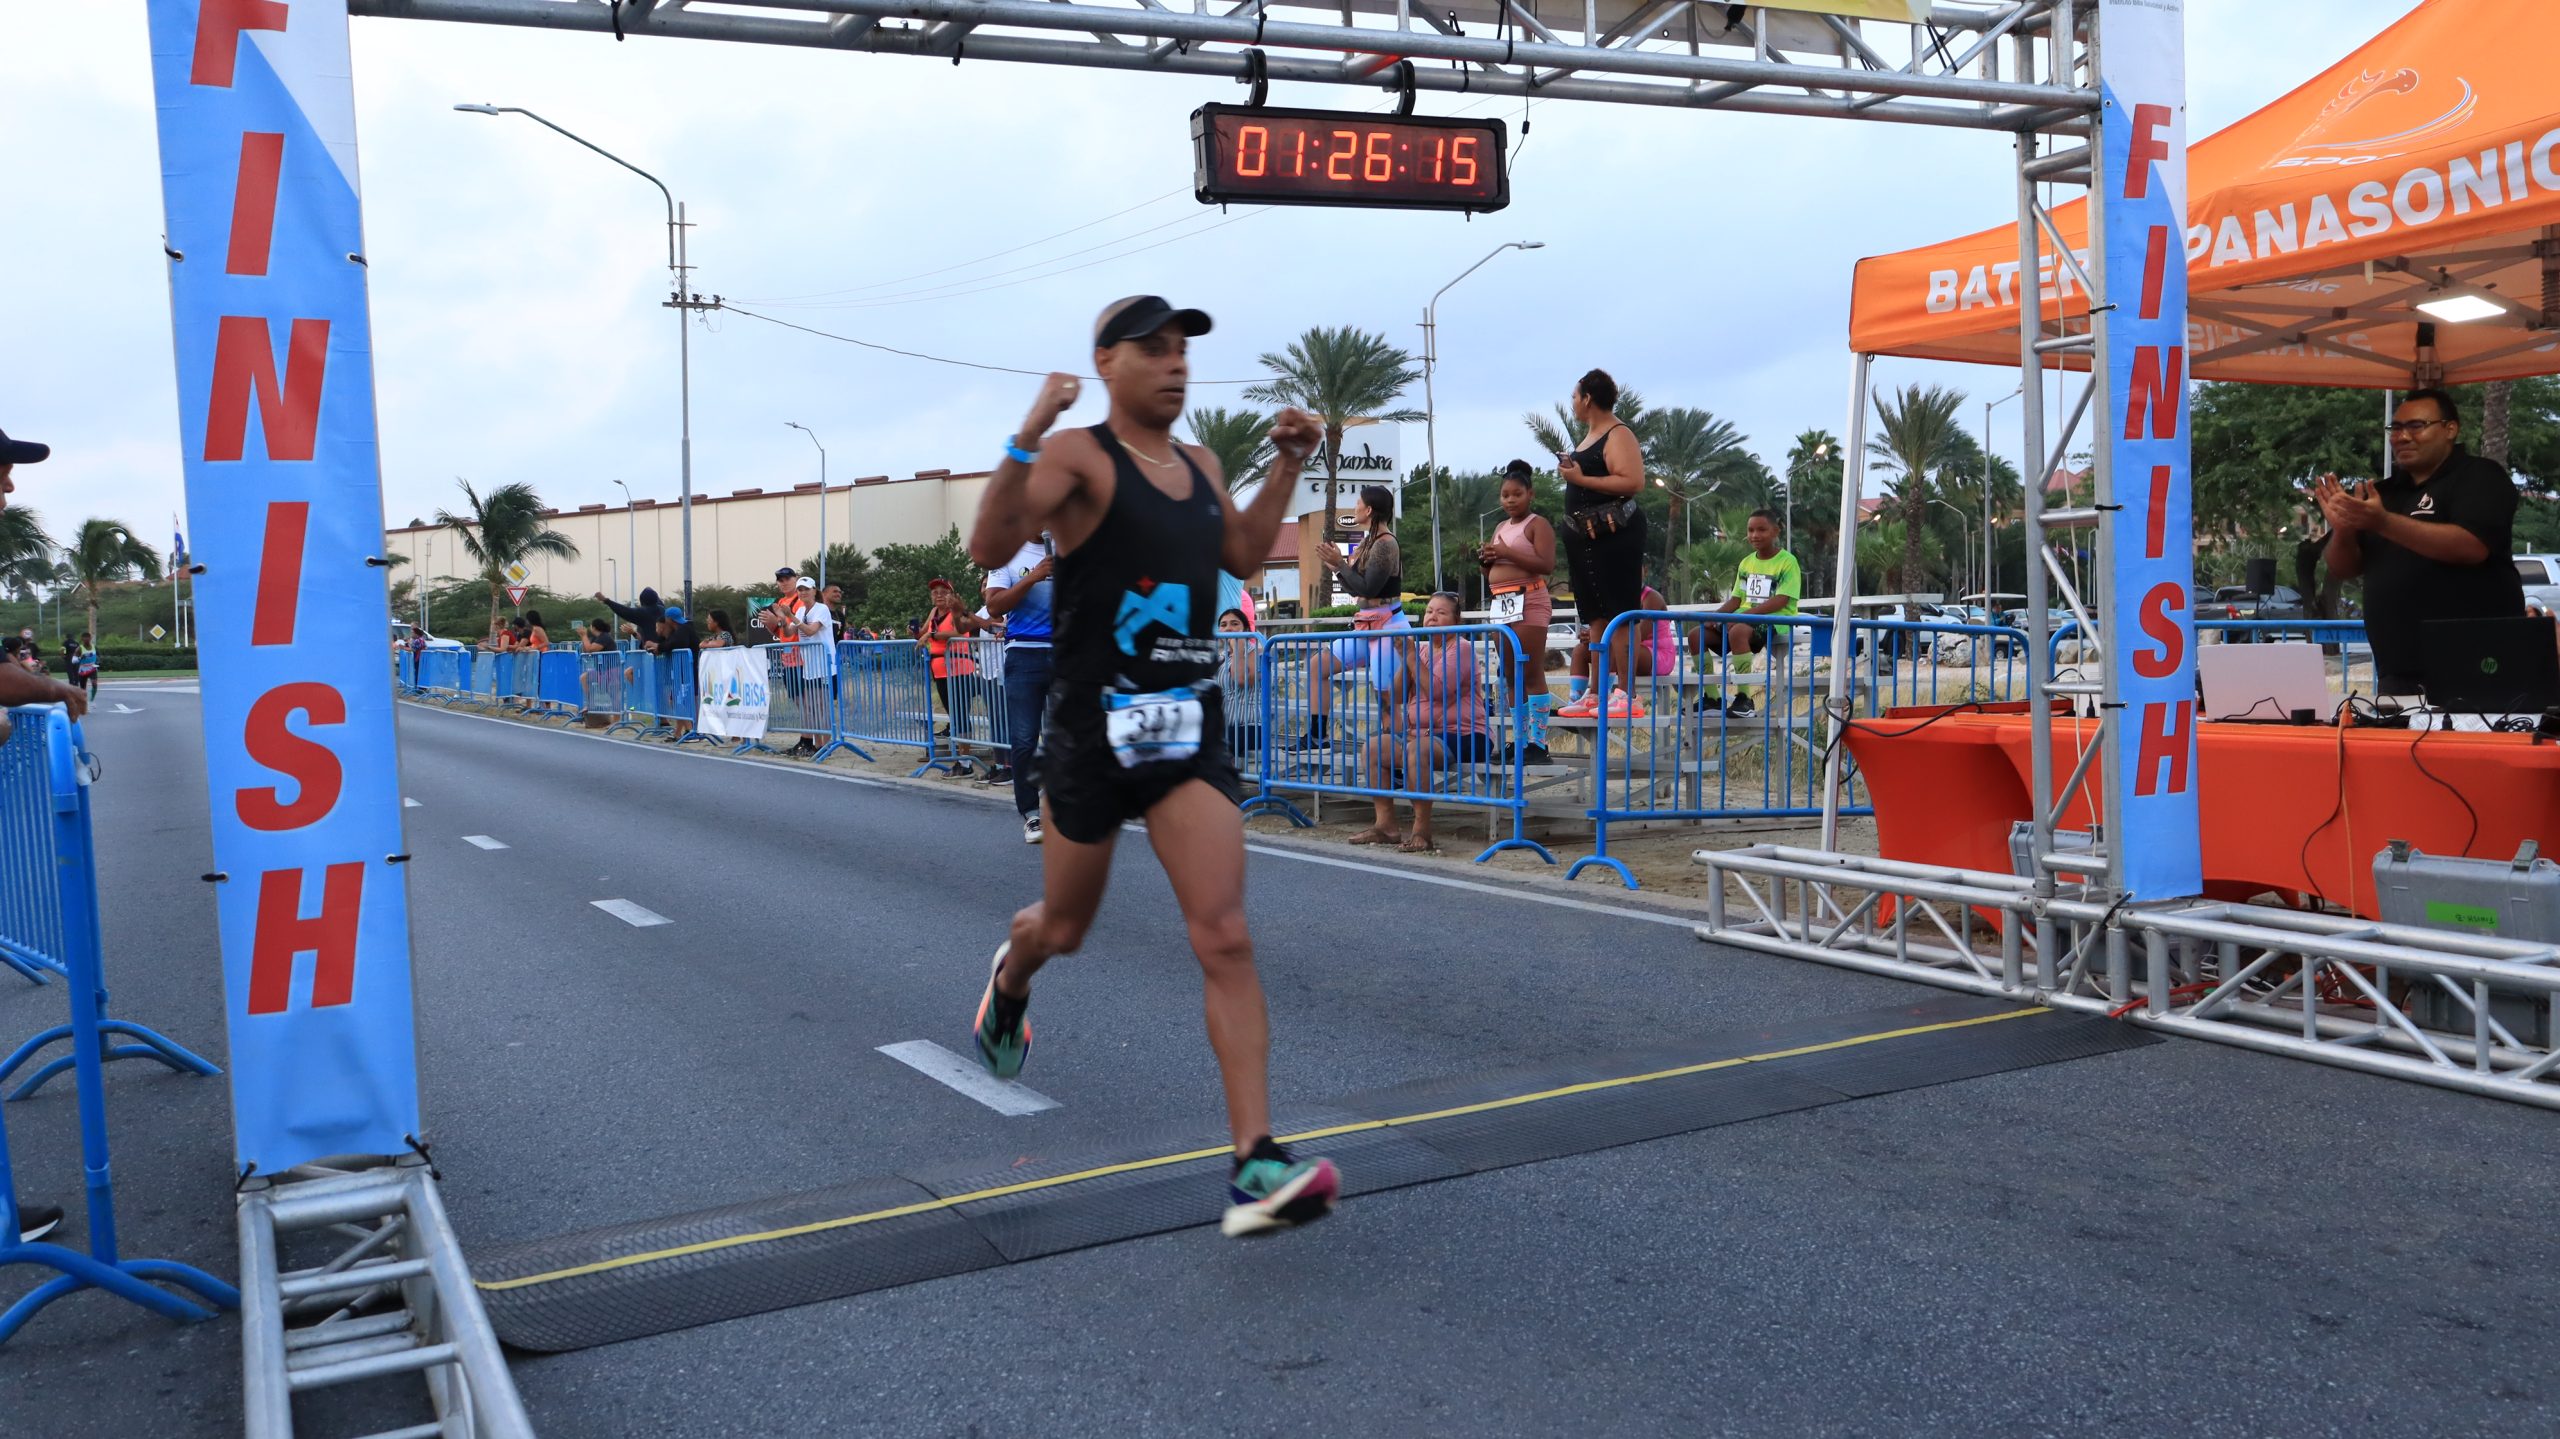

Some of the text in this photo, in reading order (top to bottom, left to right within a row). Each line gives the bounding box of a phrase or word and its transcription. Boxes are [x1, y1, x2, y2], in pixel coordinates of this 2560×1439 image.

[1236, 125, 1478, 186] 01:26:15
[2270, 155, 2405, 168] SPO
[2186, 127, 2560, 269] PANASONIC
[1304, 440, 1393, 471] Aambra
[2125, 104, 2192, 796] FINISH
[191, 0, 364, 1014] FINISH
[1749, 579, 1762, 596] 45
[1501, 598, 1516, 616] 43
[2481, 657, 2497, 674] hp
